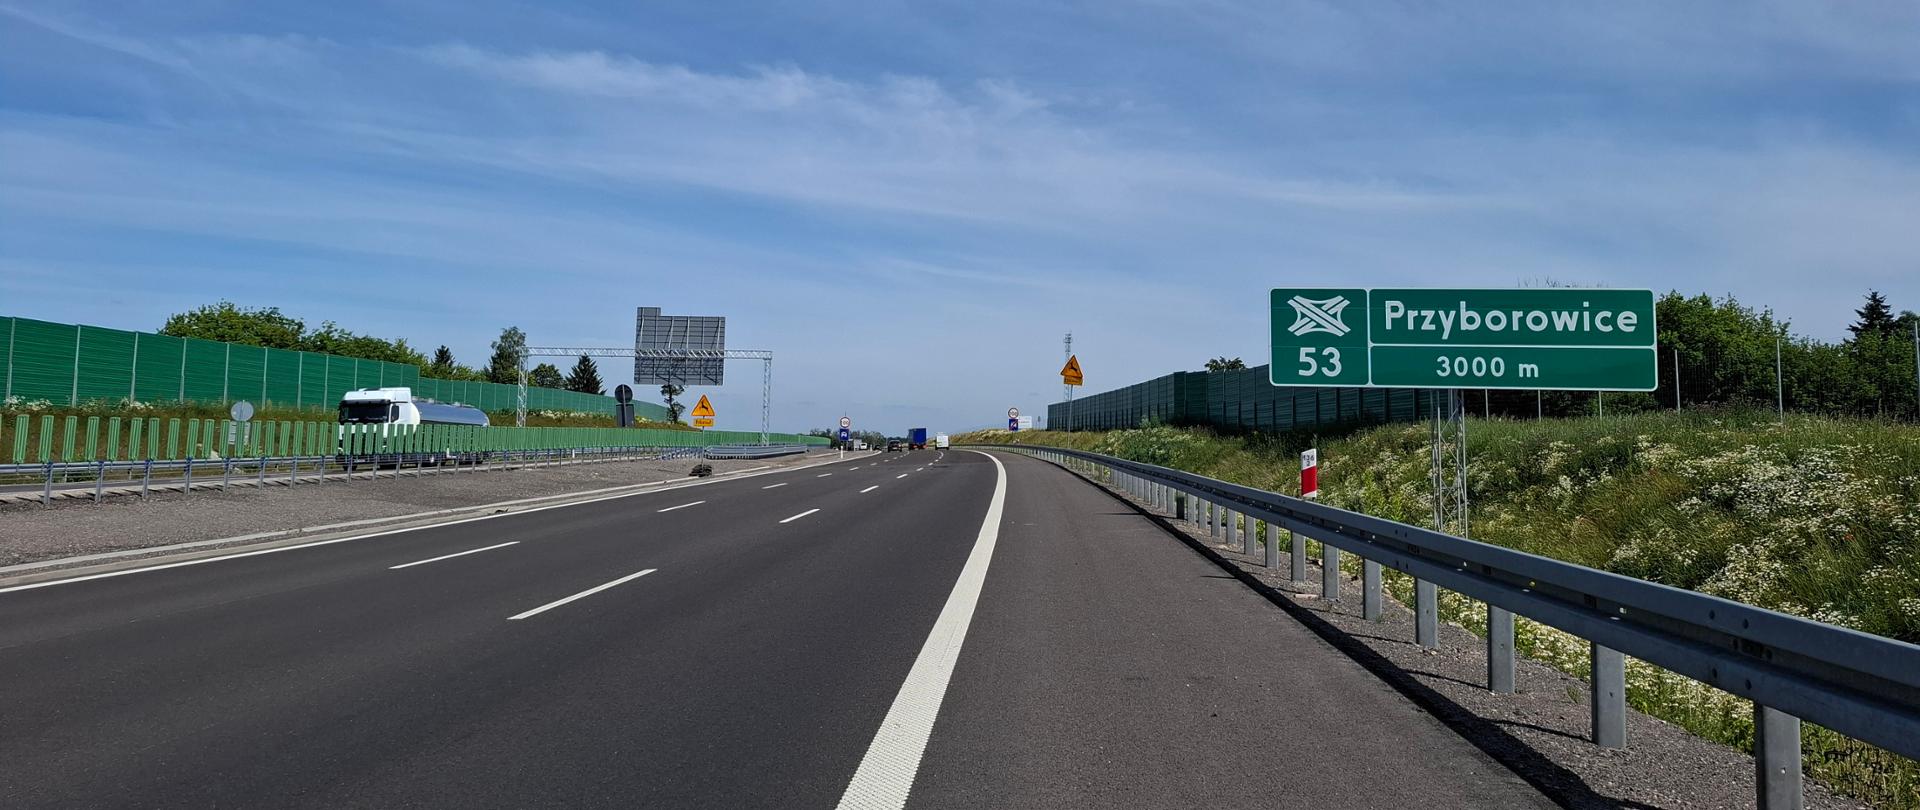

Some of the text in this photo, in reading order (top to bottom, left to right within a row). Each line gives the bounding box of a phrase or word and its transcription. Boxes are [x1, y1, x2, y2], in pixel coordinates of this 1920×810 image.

[1385, 300, 1638, 340] Przyborowice
[1298, 346, 1342, 377] 53
[1436, 355, 1539, 378] 3000 m
